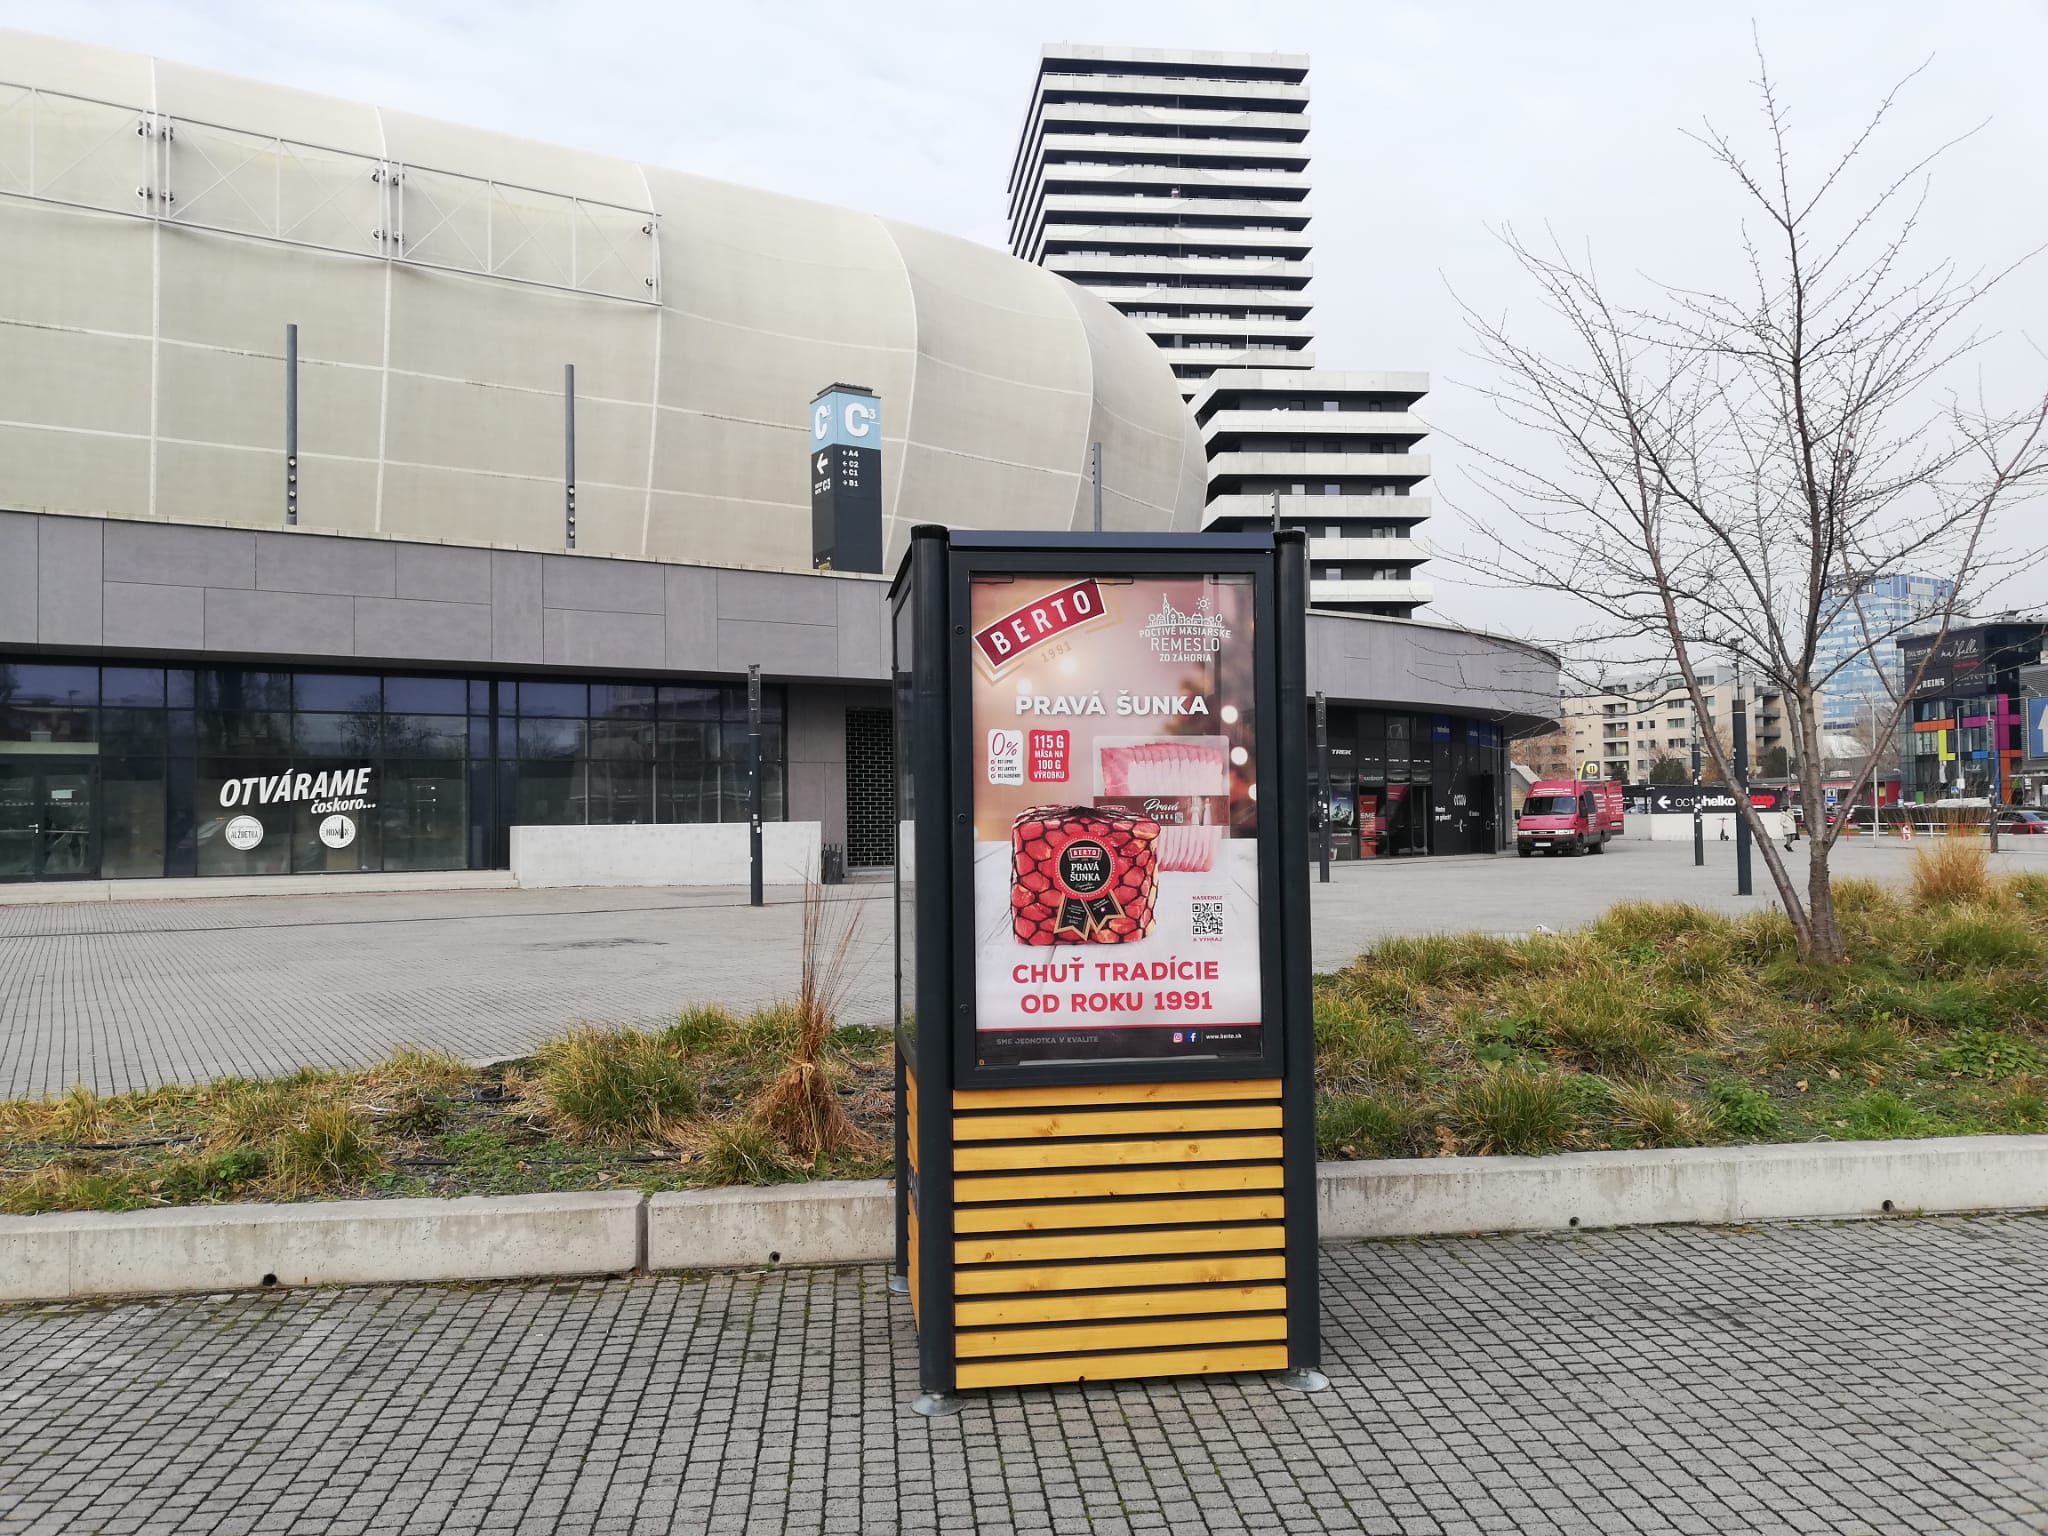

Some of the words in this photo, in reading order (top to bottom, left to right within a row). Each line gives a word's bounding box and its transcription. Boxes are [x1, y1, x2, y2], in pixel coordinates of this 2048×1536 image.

[848, 449, 859, 457] A4
[848, 460, 859, 468] C2
[990, 590, 1091, 655] BERTO
[1151, 637, 1220, 652] REMESLO
[1041, 641, 1072, 663] 1991
[1160, 653, 1170, 662] ZO
[1172, 651, 1212, 662] ZÁHORIA
[1016, 691, 1106, 716] PRAVÁ
[1116, 689, 1209, 715] ŠUNKA
[992, 732, 1019, 756] 0%
[1034, 735, 1054, 749] 115
[1056, 735, 1065, 749] G
[1054, 750, 1063, 758] NA
[1038, 760, 1053, 770] 100
[1055, 760, 1062, 770] G
[219, 767, 372, 807] OTVÁRAME
[311, 797, 376, 814] čoskoro...
[1071, 861, 1099, 872] PRAVÁ
[1070, 872, 1100, 881] ŠUNKA
[1012, 957, 1085, 983] CHUŤ
[1095, 956, 1219, 982] TRADÍCIE
[1020, 994, 1060, 1014] OD
[1071, 992, 1143, 1013] ROKU
[1154, 991, 1213, 1011] 1991
[1015, 1037, 1057, 1045] JEDNOTKA
